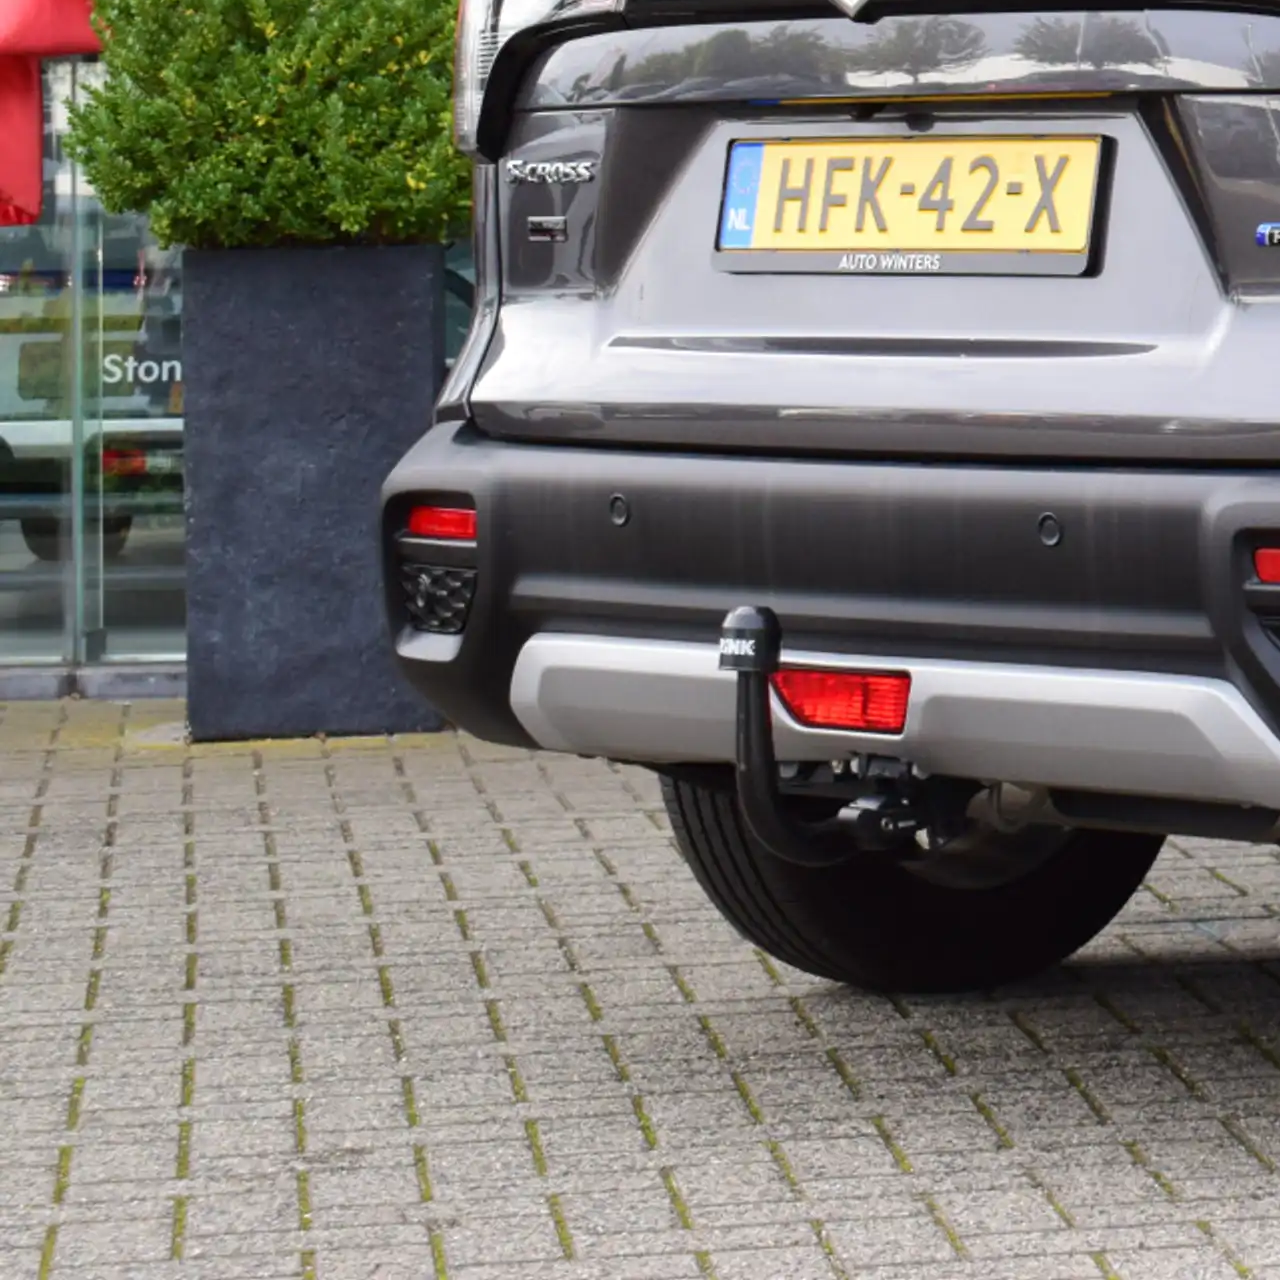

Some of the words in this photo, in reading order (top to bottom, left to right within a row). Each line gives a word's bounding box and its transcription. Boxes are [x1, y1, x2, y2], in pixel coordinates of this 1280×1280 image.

[772, 154, 1071, 233] HFK-42-X
[726, 206, 752, 232] NL
[837, 253, 878, 272] AUTO
